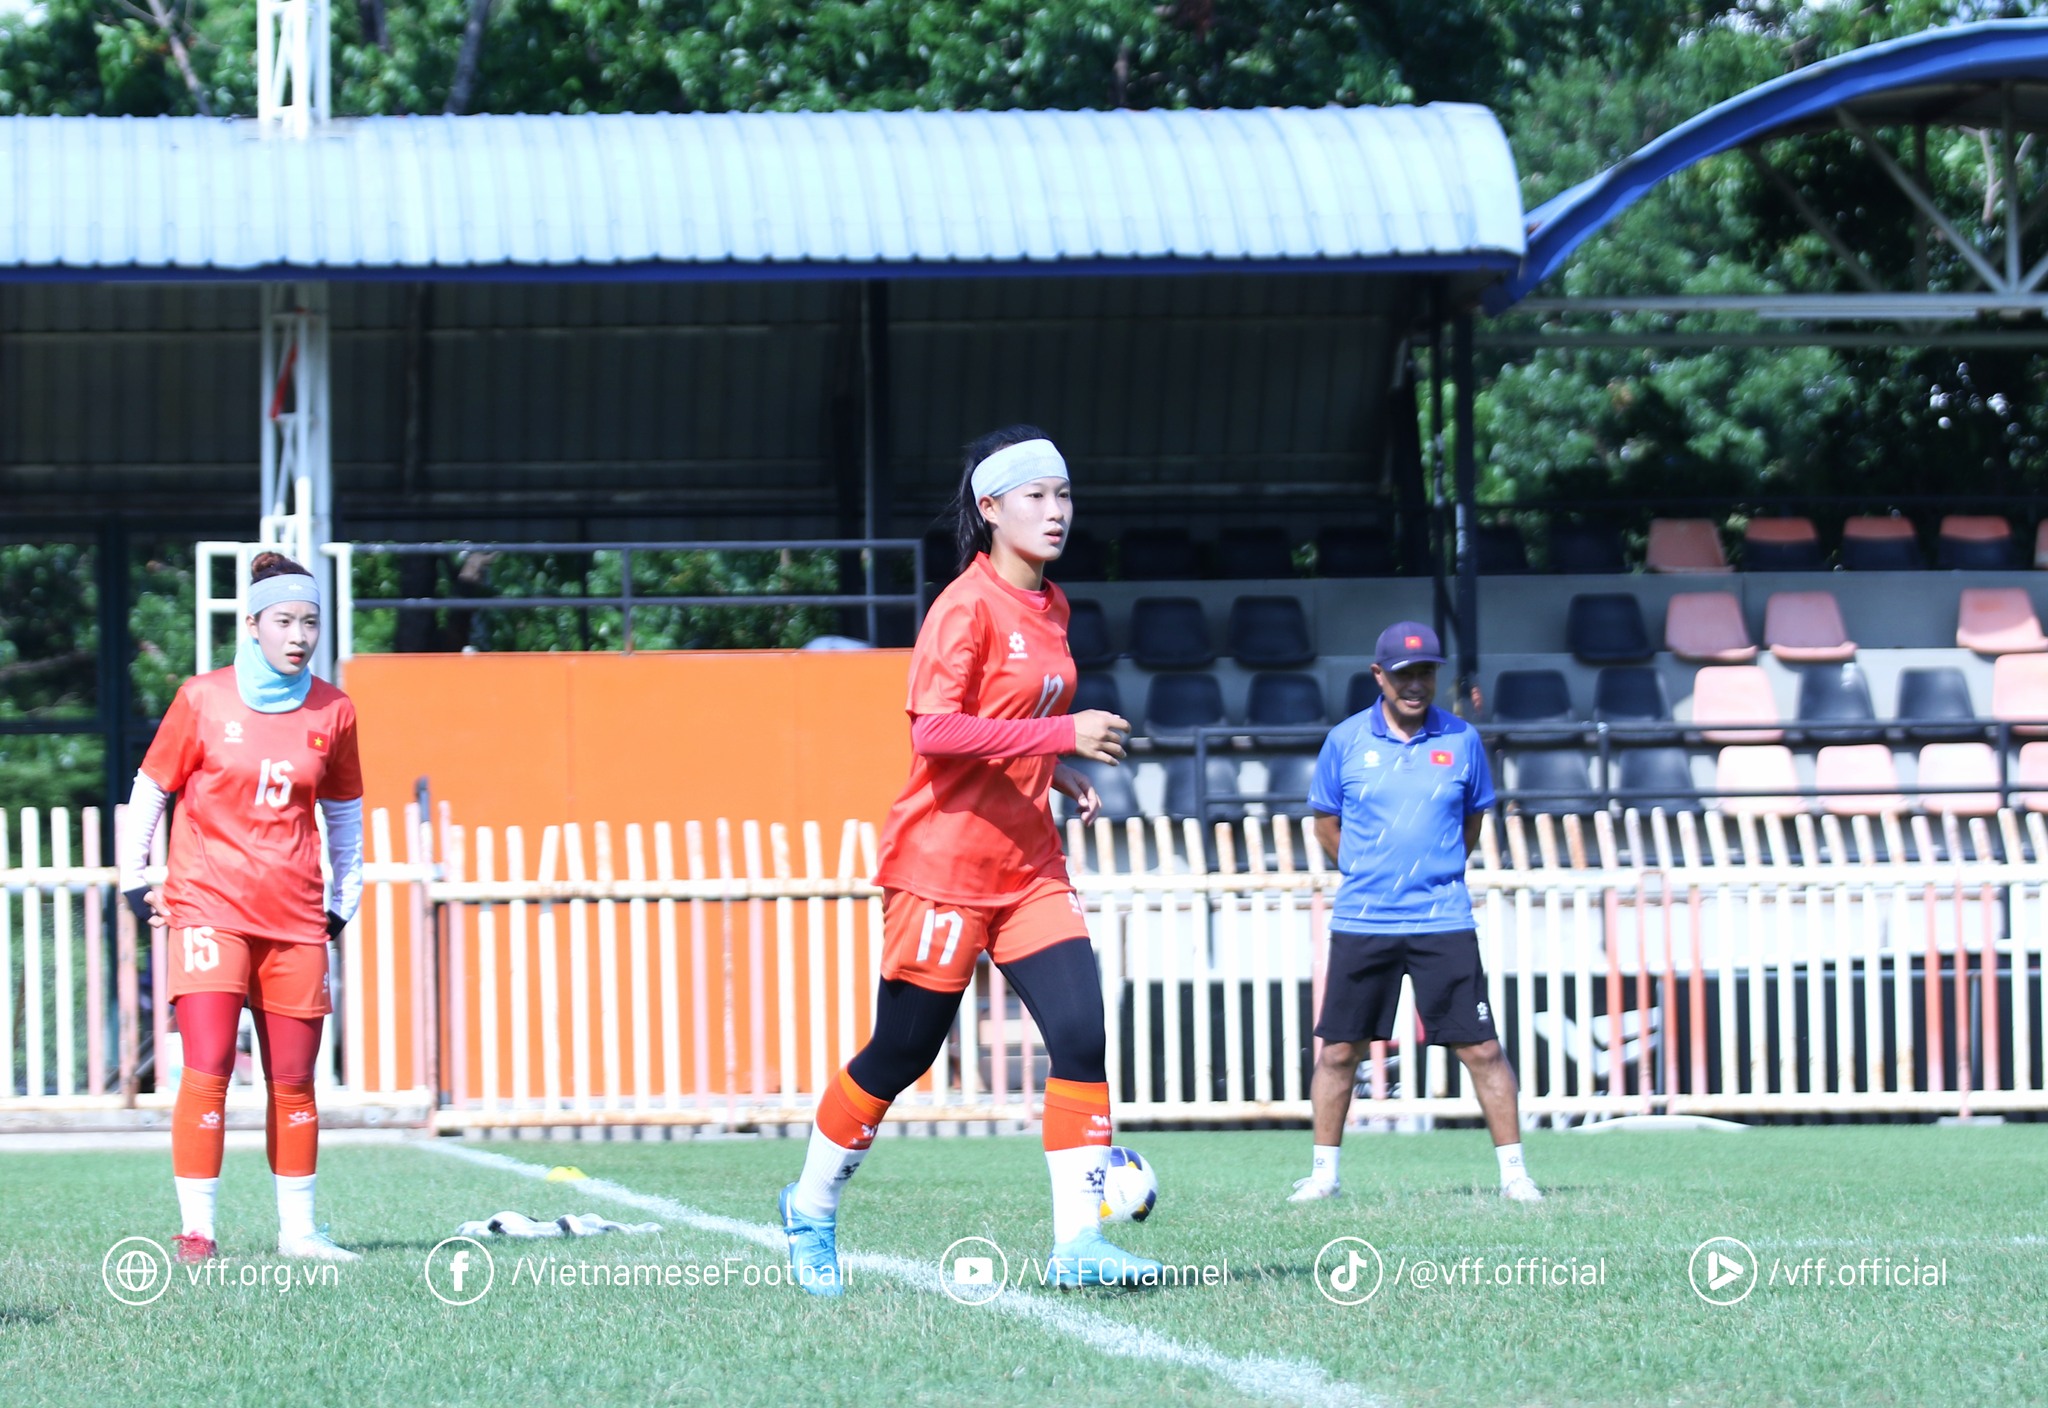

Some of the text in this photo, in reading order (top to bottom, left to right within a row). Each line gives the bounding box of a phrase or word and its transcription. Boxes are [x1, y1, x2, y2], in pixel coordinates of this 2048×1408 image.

[254, 758, 295, 808] 15
[182, 926, 220, 973] 15
[916, 908, 964, 966] 17
